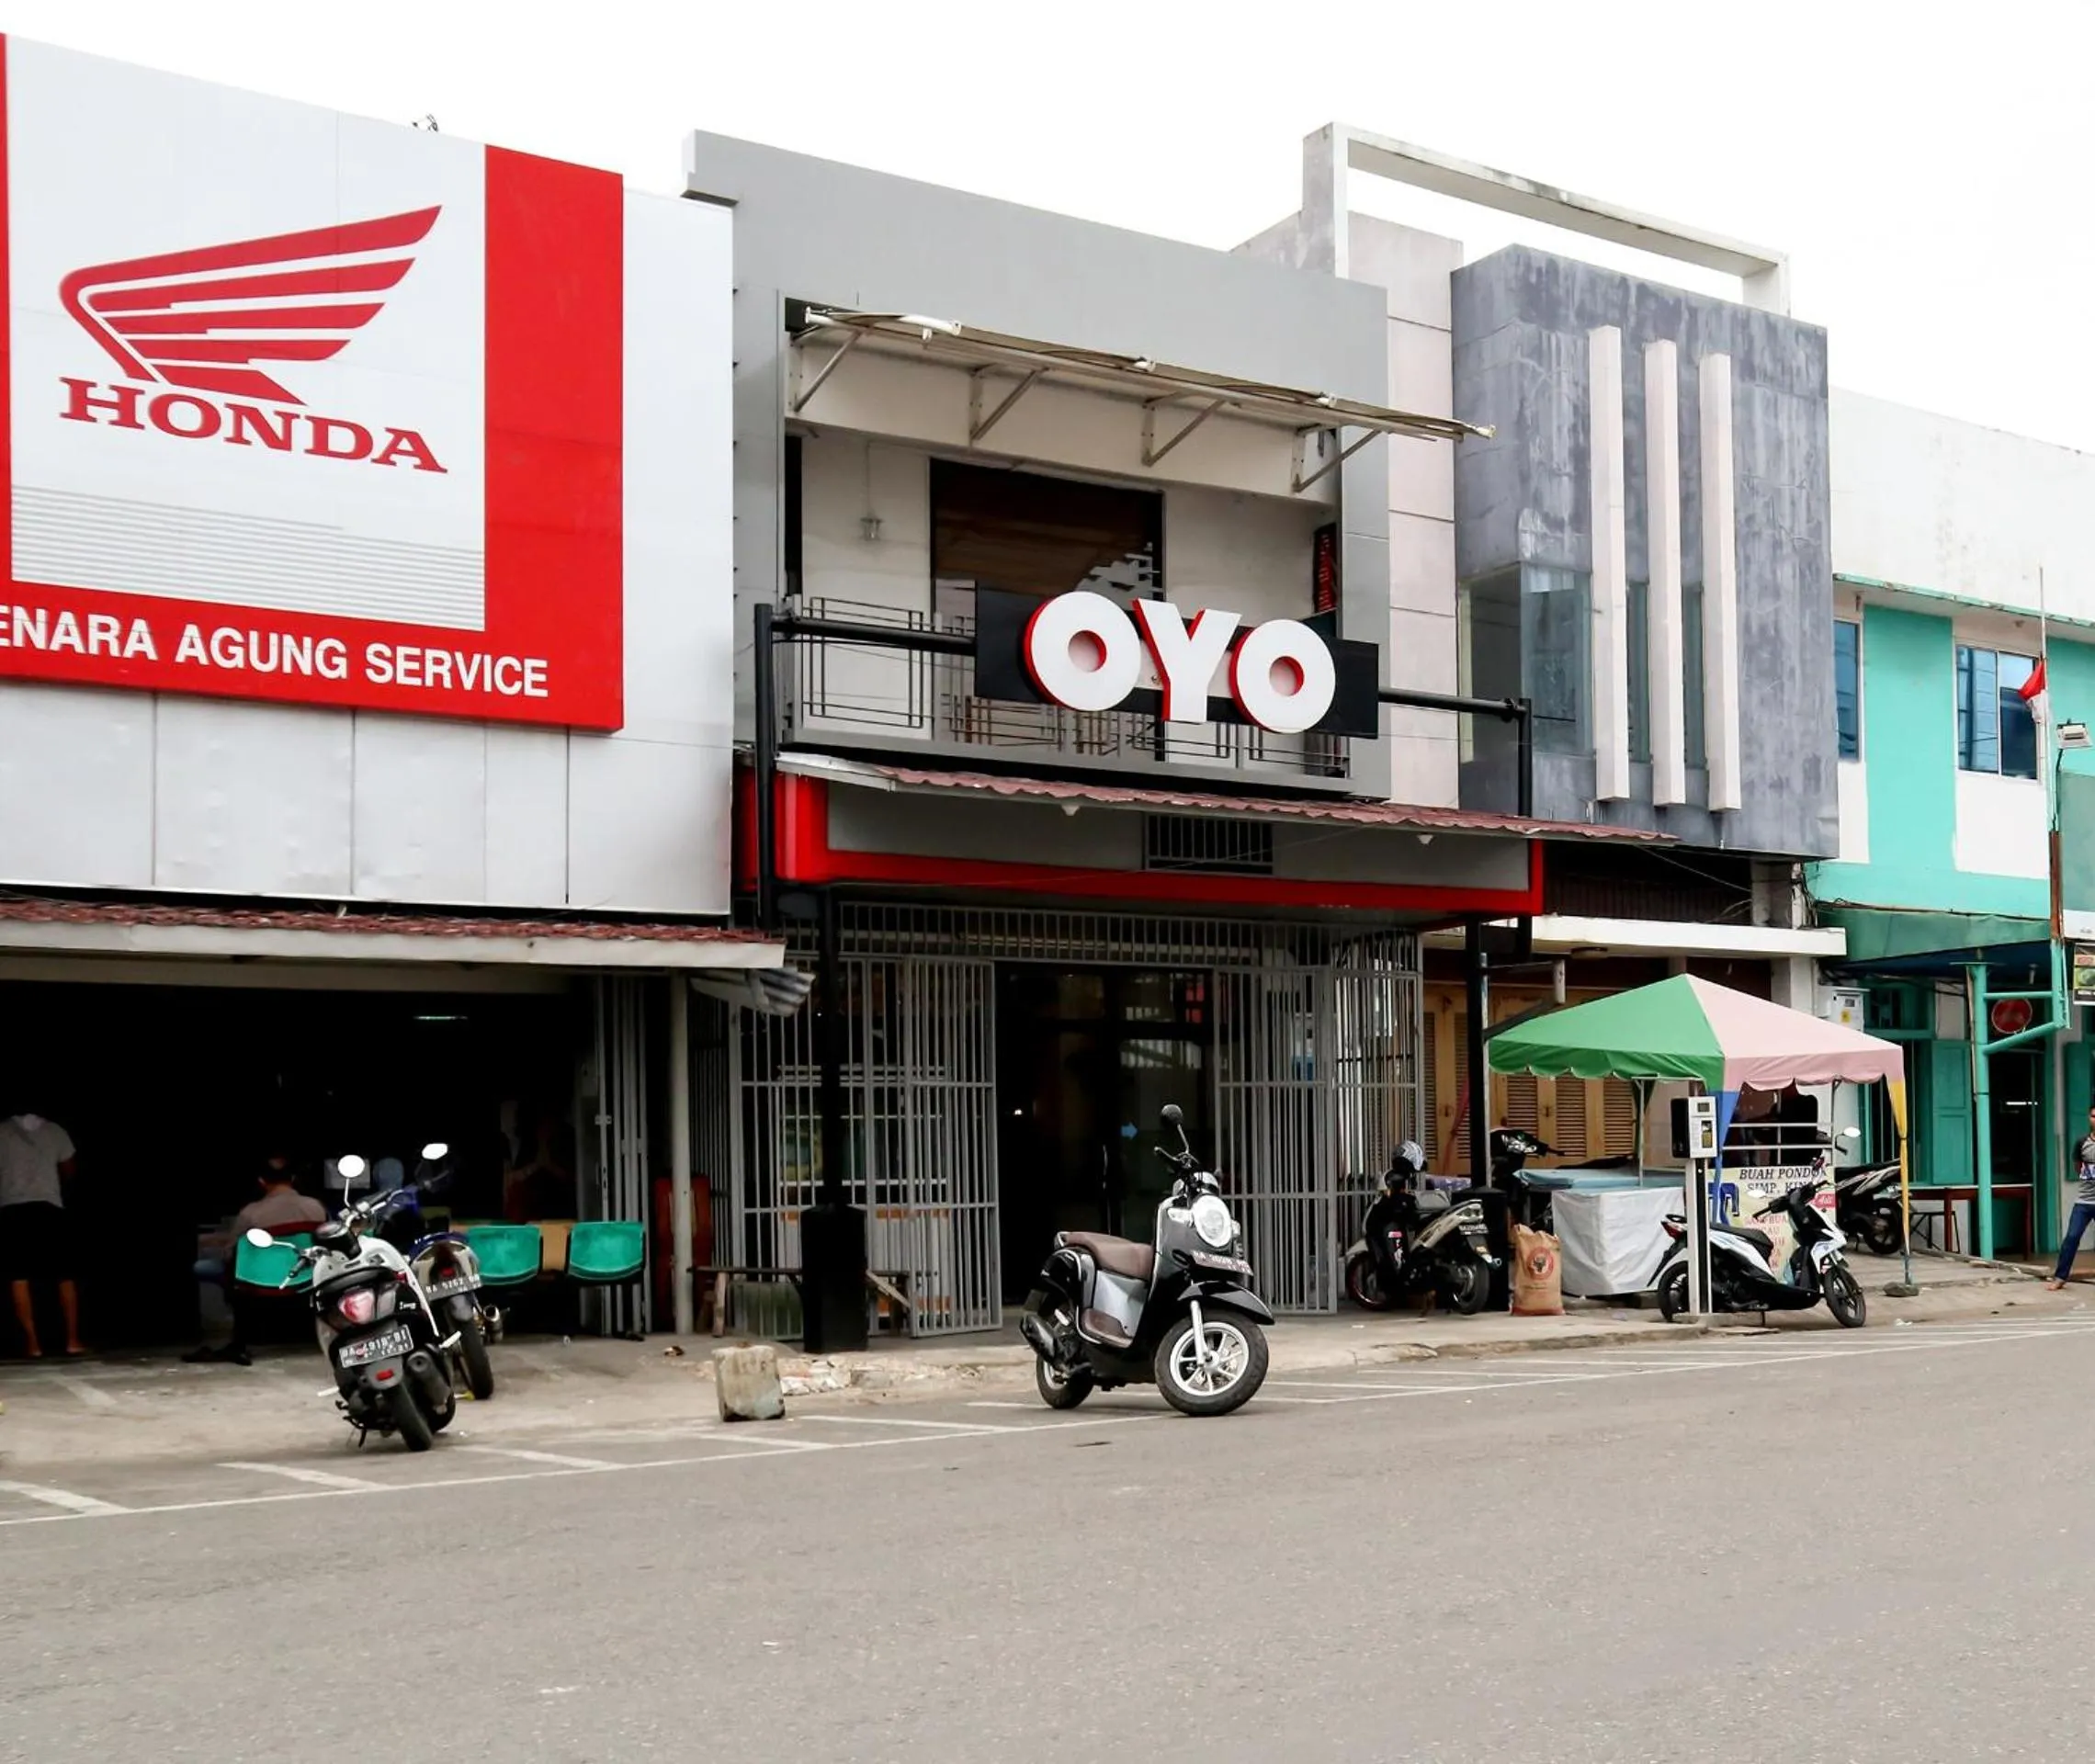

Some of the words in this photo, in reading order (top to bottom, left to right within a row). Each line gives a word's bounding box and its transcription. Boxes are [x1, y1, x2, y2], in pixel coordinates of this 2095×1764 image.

[59, 377, 447, 473] HONDA
[176, 623, 347, 679] AGUNG
[365, 642, 548, 697] SERVICE
[1023, 591, 1336, 733] OYO
[1739, 1168, 1773, 1180] BUAH
